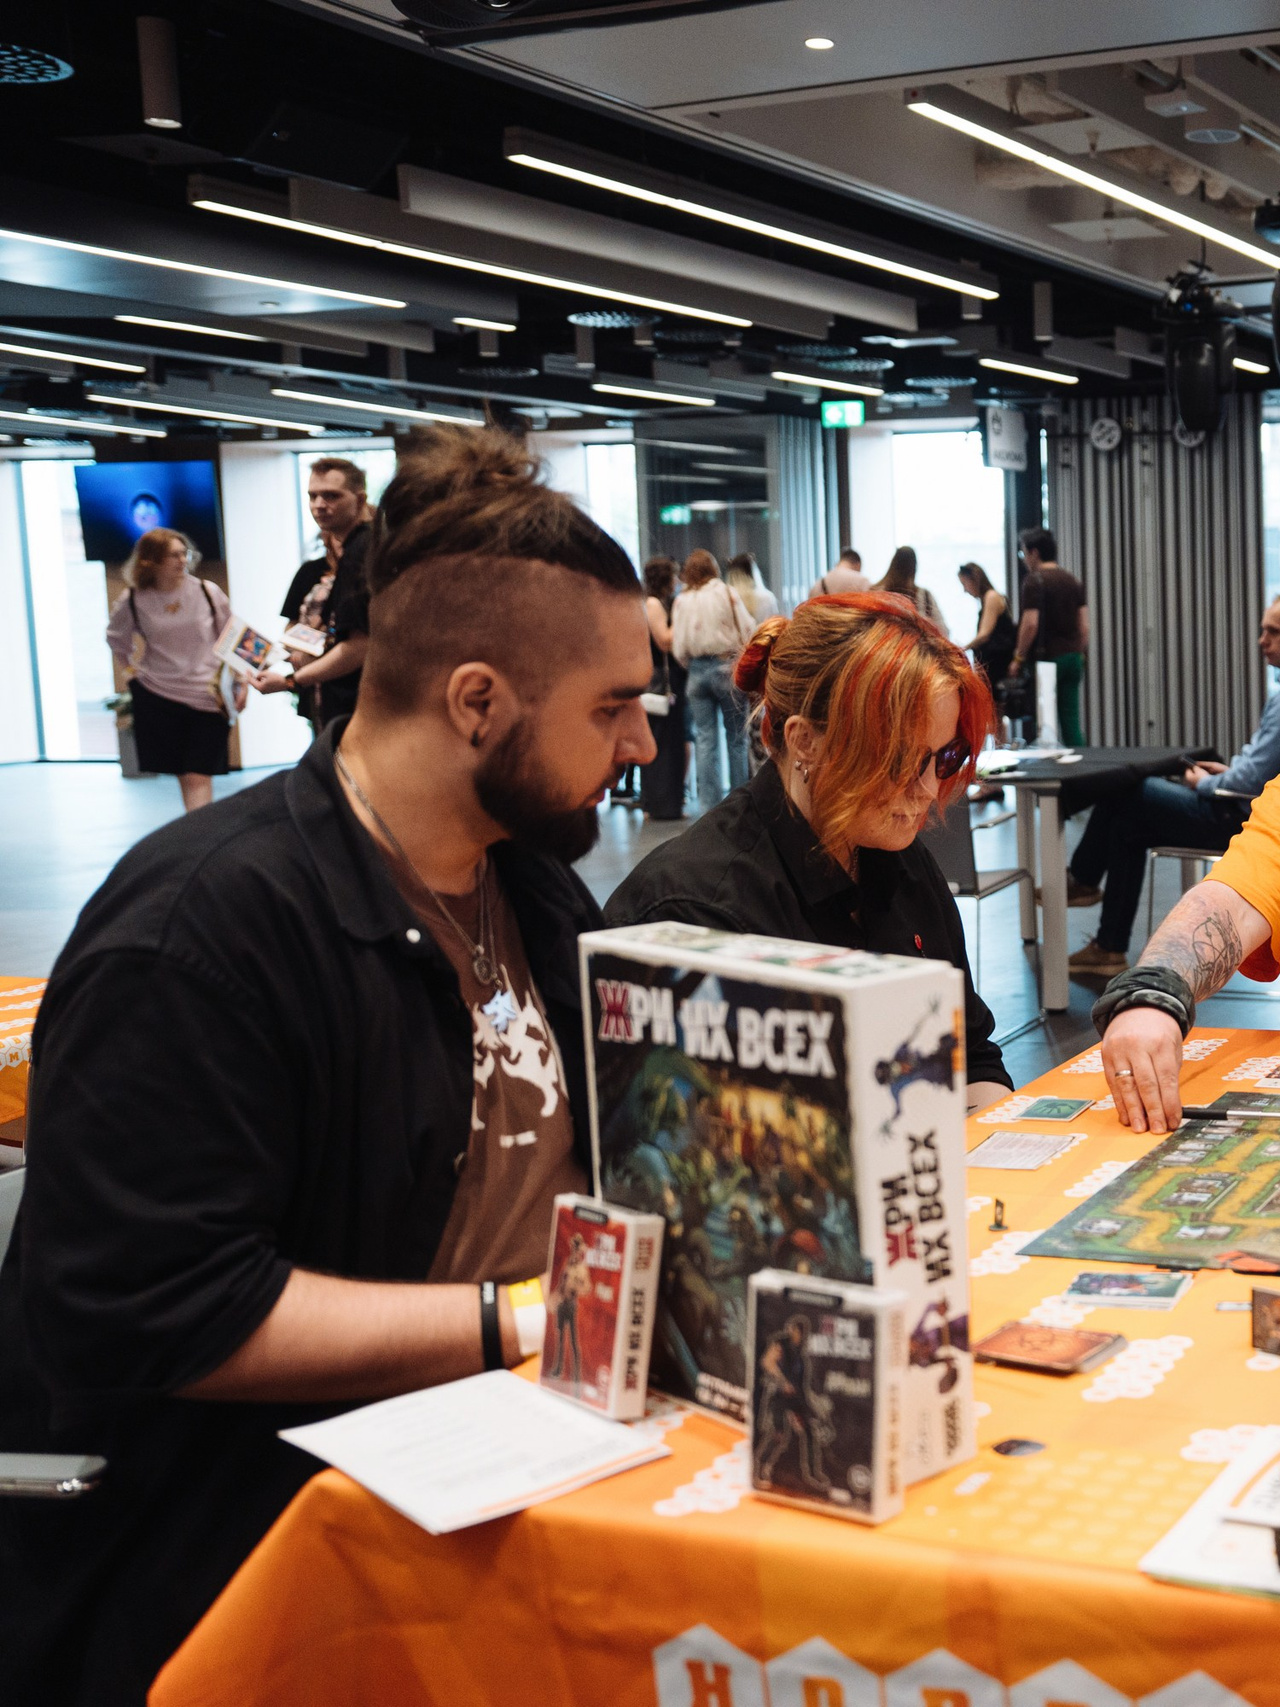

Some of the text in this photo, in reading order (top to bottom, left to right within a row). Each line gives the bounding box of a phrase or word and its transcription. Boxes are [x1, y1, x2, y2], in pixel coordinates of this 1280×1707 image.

[596, 978, 677, 1046] ЖРИ
[736, 1006, 837, 1079] ВСЕХ
[880, 1172, 917, 1266] ЖРИ
[907, 1129, 952, 1285] ИХ ВСЕХ
